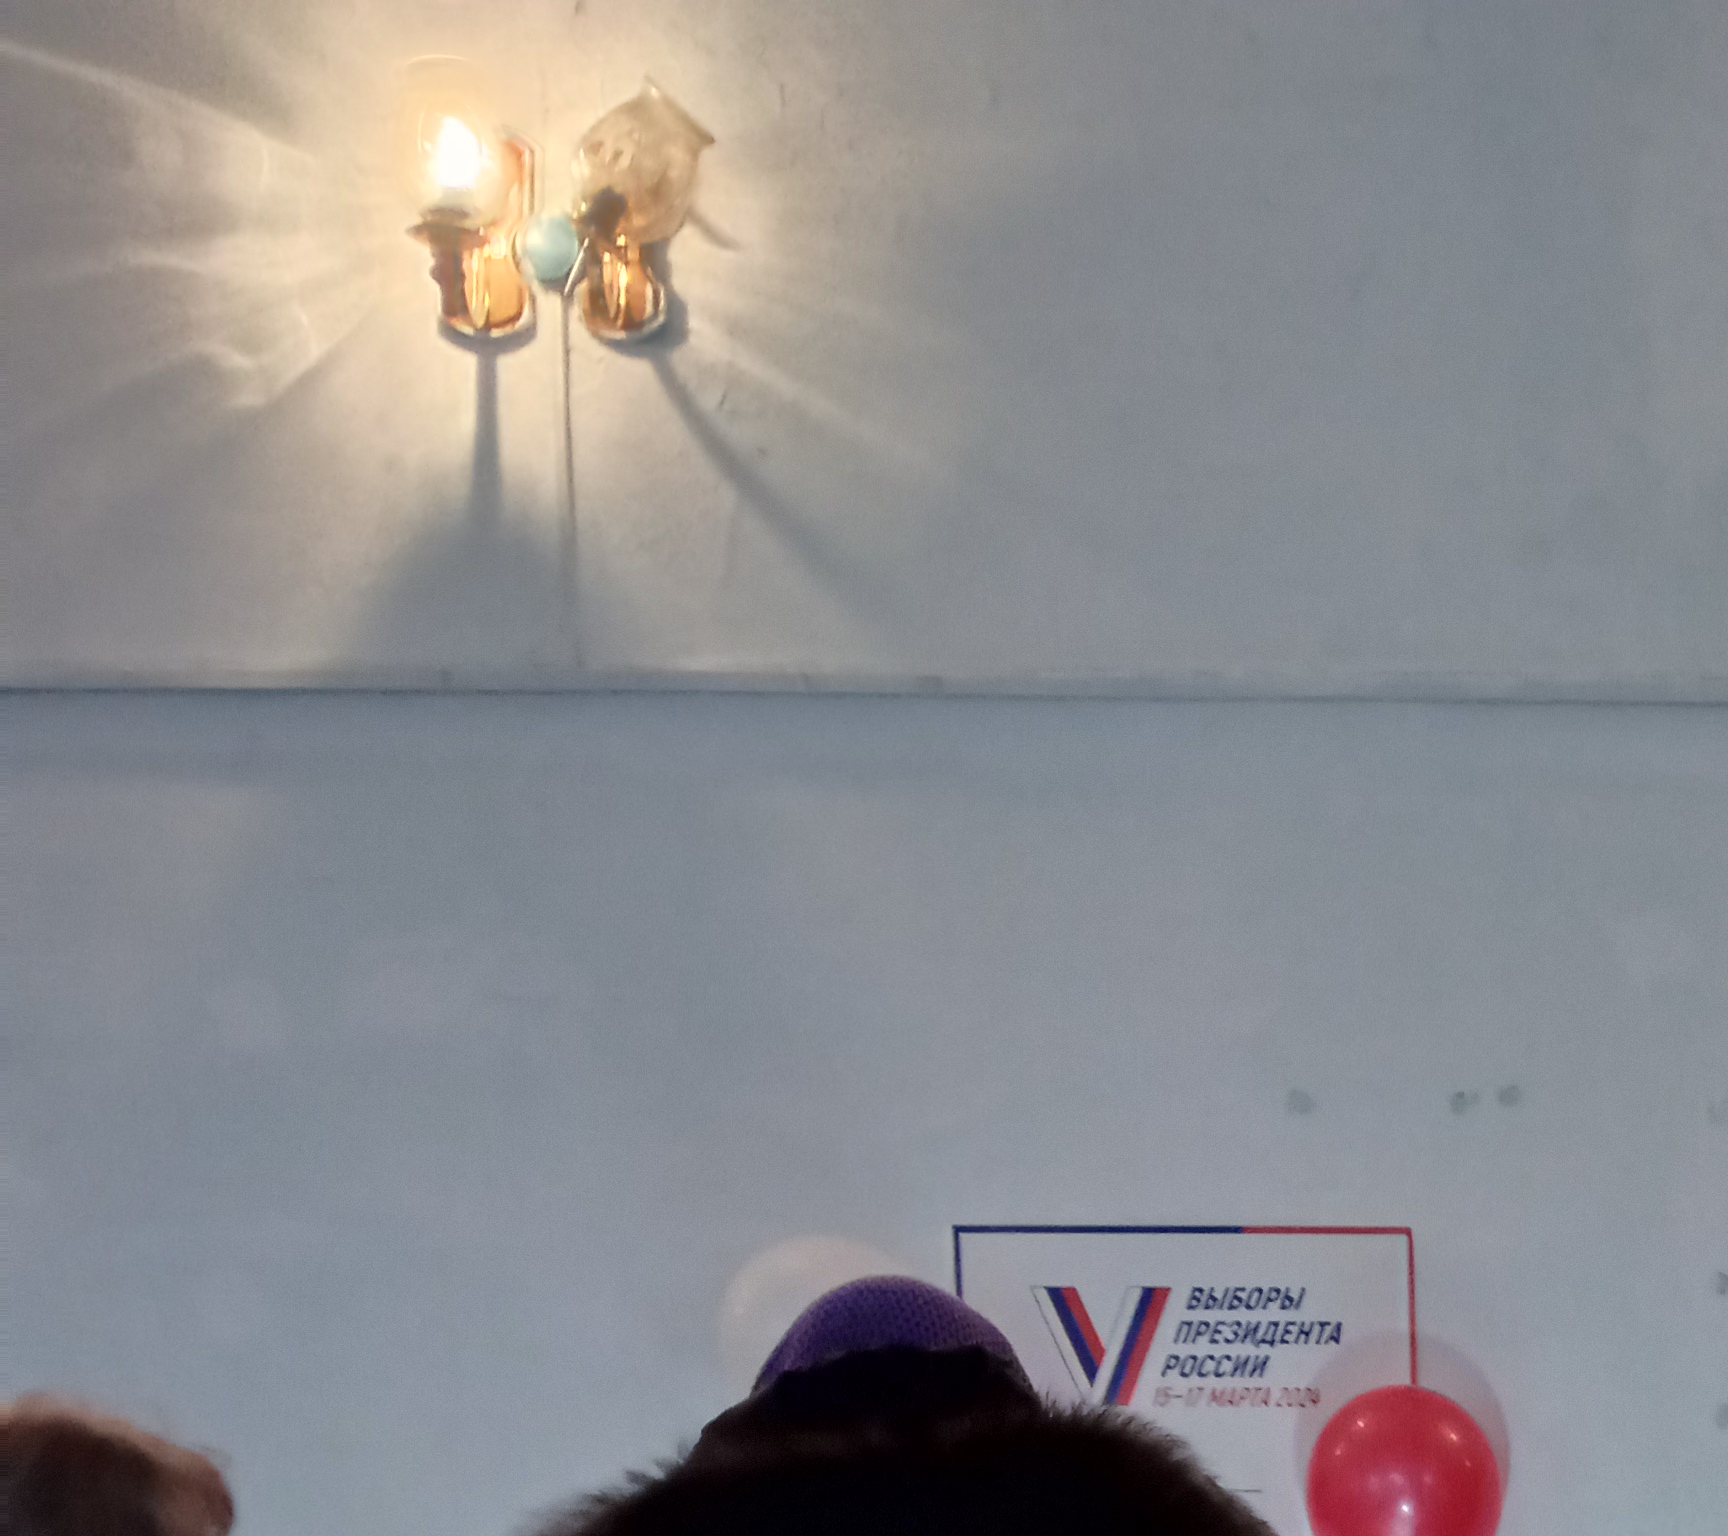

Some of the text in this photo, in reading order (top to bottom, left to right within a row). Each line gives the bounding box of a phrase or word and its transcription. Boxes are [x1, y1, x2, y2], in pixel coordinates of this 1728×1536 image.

[1186, 1286, 1307, 1311] ВЫБОРЫ
[1172, 1320, 1343, 1348] ПРЕЗИДЕНТА
[1160, 1353, 1271, 1379] РОССИИ
[1206, 1386, 1271, 1408] МАРТА
